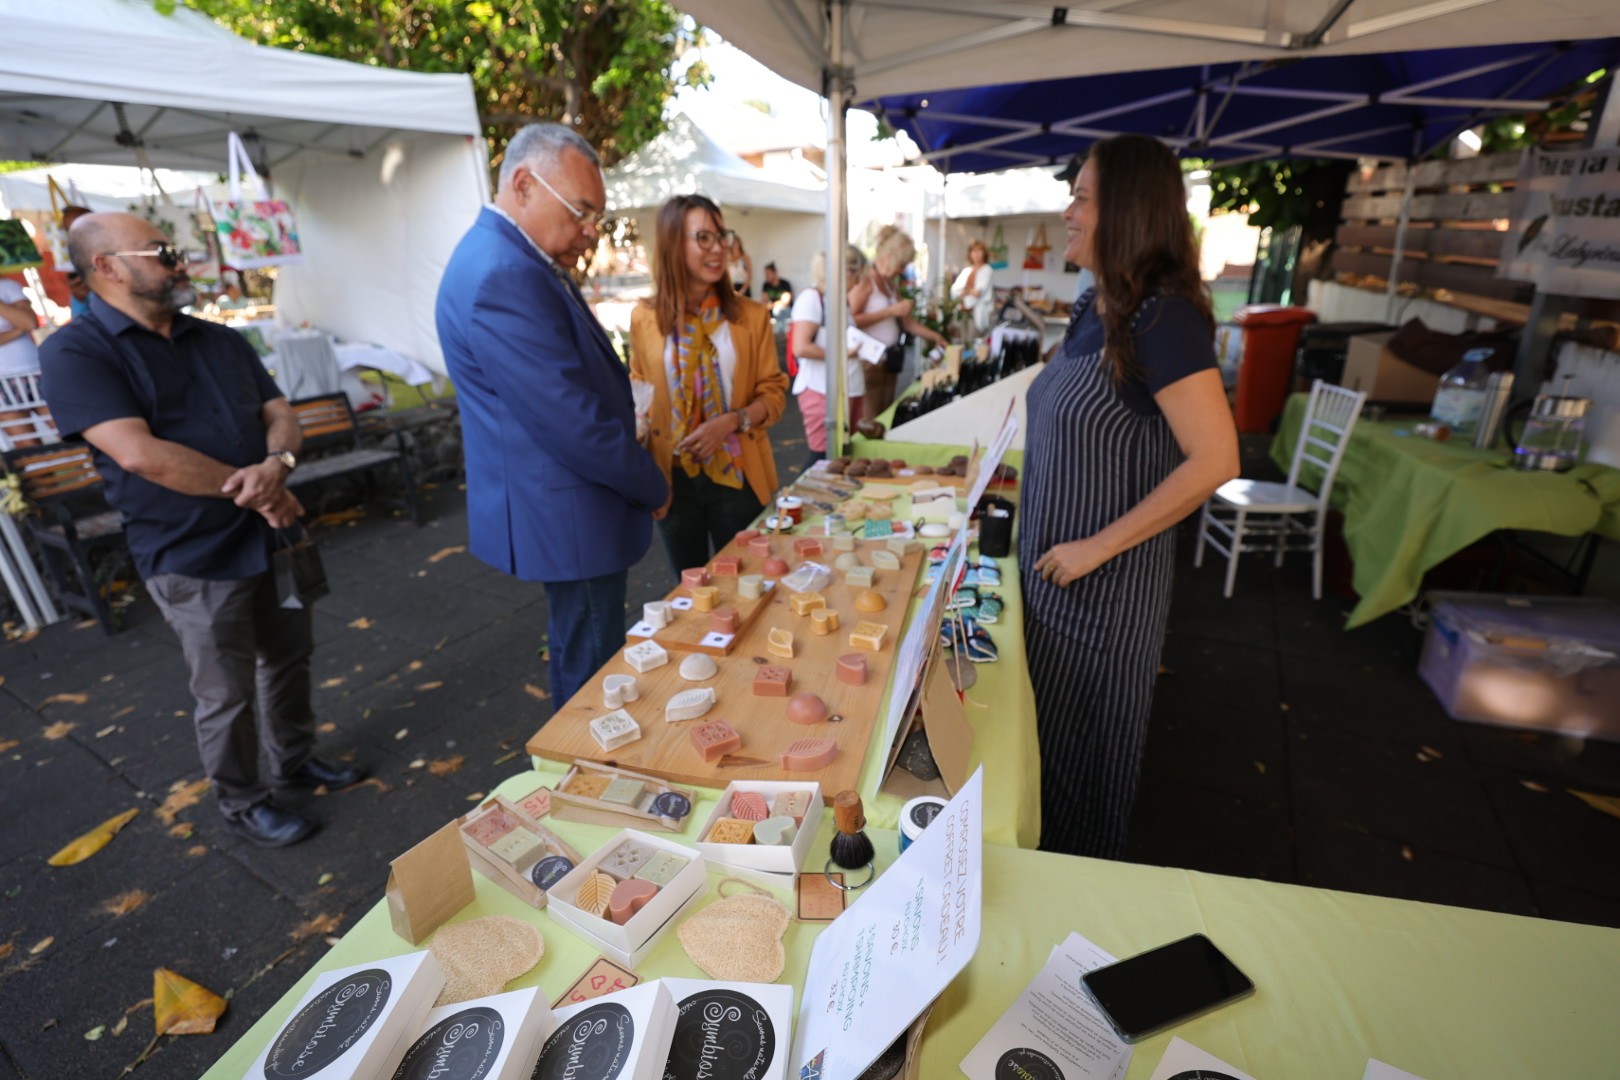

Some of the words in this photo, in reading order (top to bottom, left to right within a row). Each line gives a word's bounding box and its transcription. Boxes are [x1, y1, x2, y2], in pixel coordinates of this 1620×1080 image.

[944, 814, 955, 879] COFFRET
[957, 799, 969, 883] COMPOSEZ
[910, 887, 924, 951] SAVONS
[938, 881, 951, 954] CADEAU
[954, 881, 967, 946] VOTRE
[843, 937, 865, 1031] SHAMPOING
[860, 934, 876, 998] SAVONS
[291, 983, 370, 1071] Symbiose
[680, 1000, 697, 1016] créat
[695, 1001, 742, 1080] Symbios
[427, 1022, 479, 1080] Symb
[563, 1018, 607, 1080] Symbi
[1008, 1059, 1035, 1080] biose
